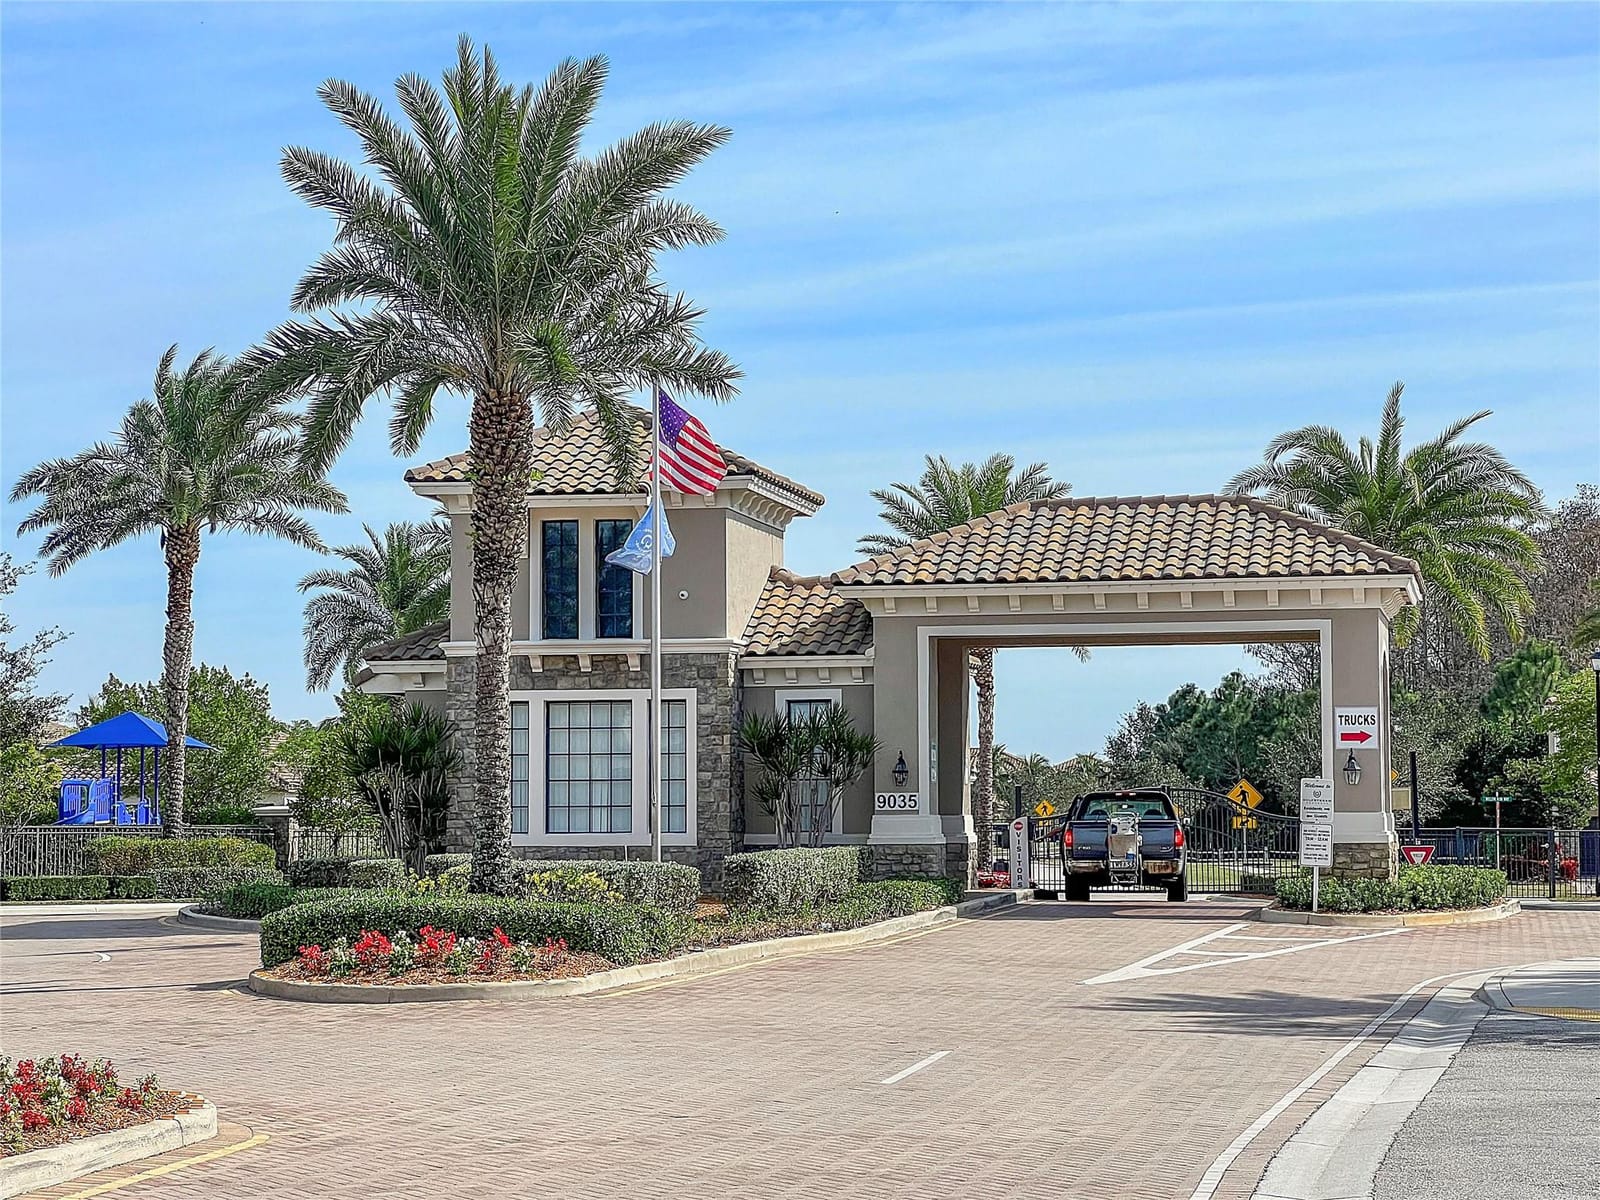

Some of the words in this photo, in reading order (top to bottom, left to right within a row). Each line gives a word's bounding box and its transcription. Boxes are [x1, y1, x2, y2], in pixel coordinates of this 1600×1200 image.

[1338, 714, 1376, 726] TRUCKS
[877, 794, 918, 809] 9035
[1015, 832, 1023, 888] VISITORS
